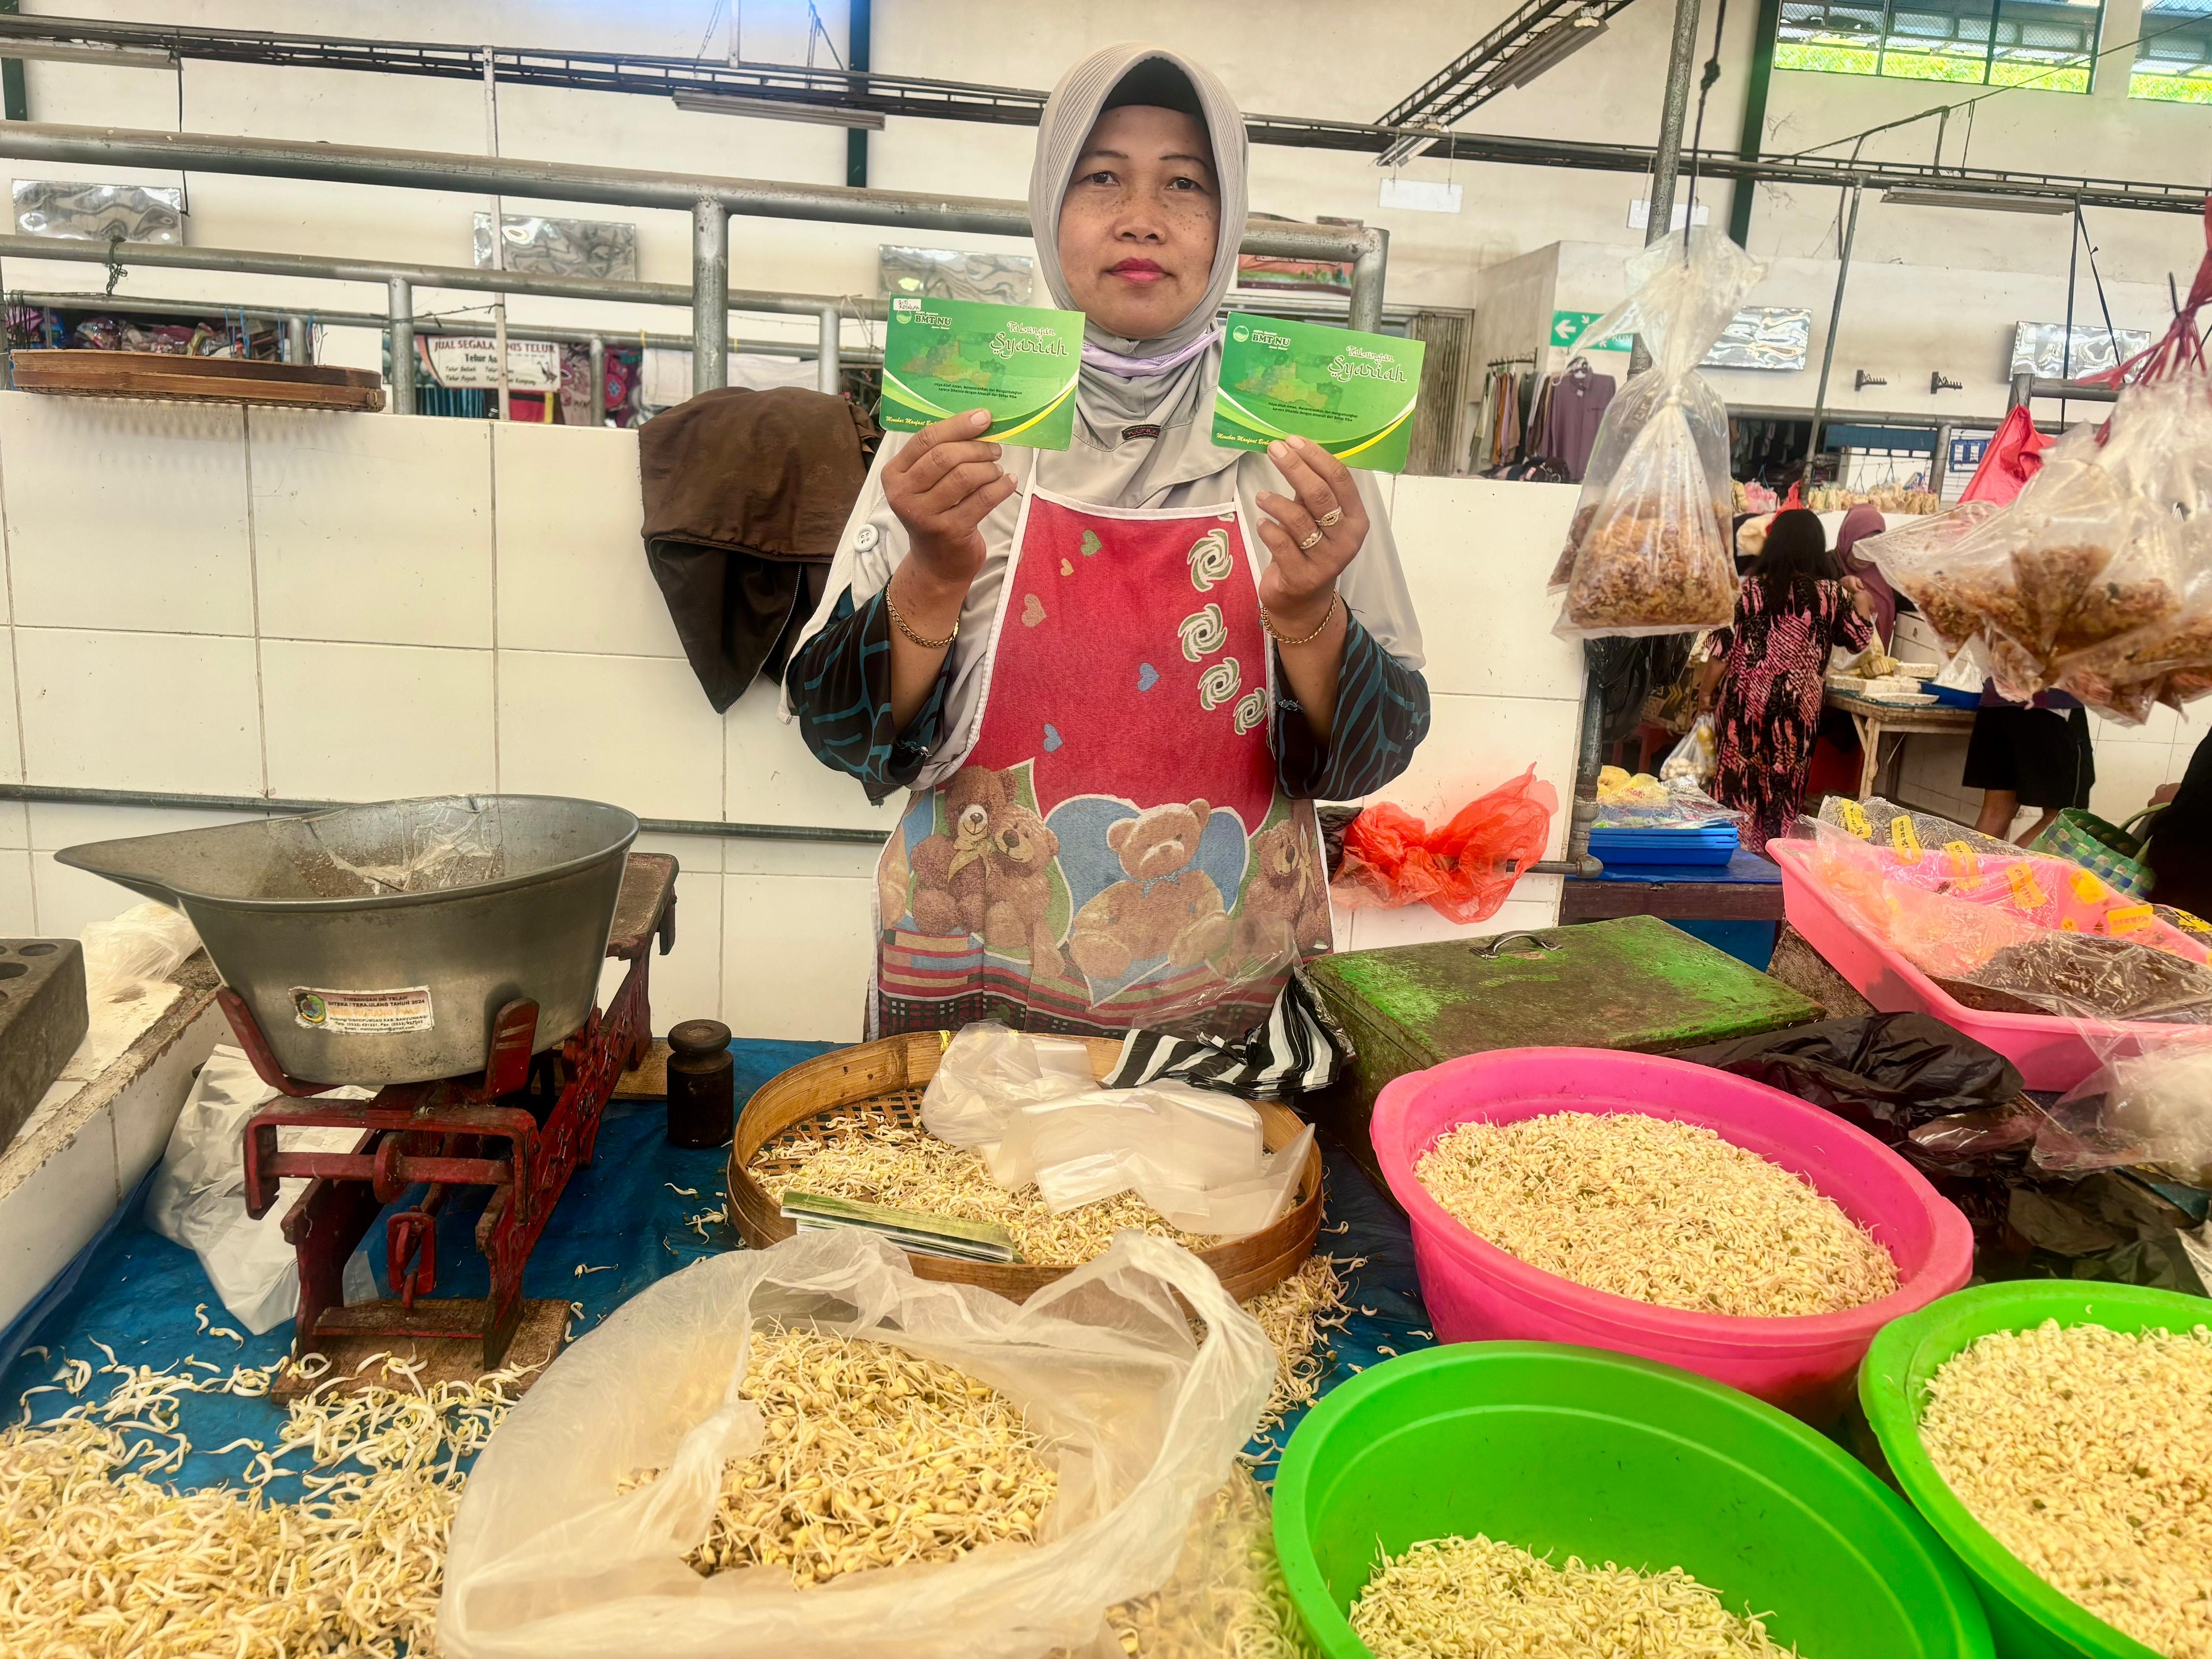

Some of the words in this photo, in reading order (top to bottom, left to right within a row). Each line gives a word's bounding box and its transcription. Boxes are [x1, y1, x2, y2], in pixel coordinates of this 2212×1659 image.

[915, 314, 936, 324] BMT
[936, 316, 952, 326] NU
[1007, 321, 1055, 339] Tabungan
[434, 341, 456, 352] JUAL
[458, 340, 495, 349] SEGALA
[525, 343, 555, 353] TELUR
[990, 332, 1069, 359] Syariah
[1252, 333, 1274, 344] BMT
[1274, 336, 1291, 347] NU
[1346, 346, 1395, 364] Tabungan
[1328, 355, 1407, 382] Syariah
